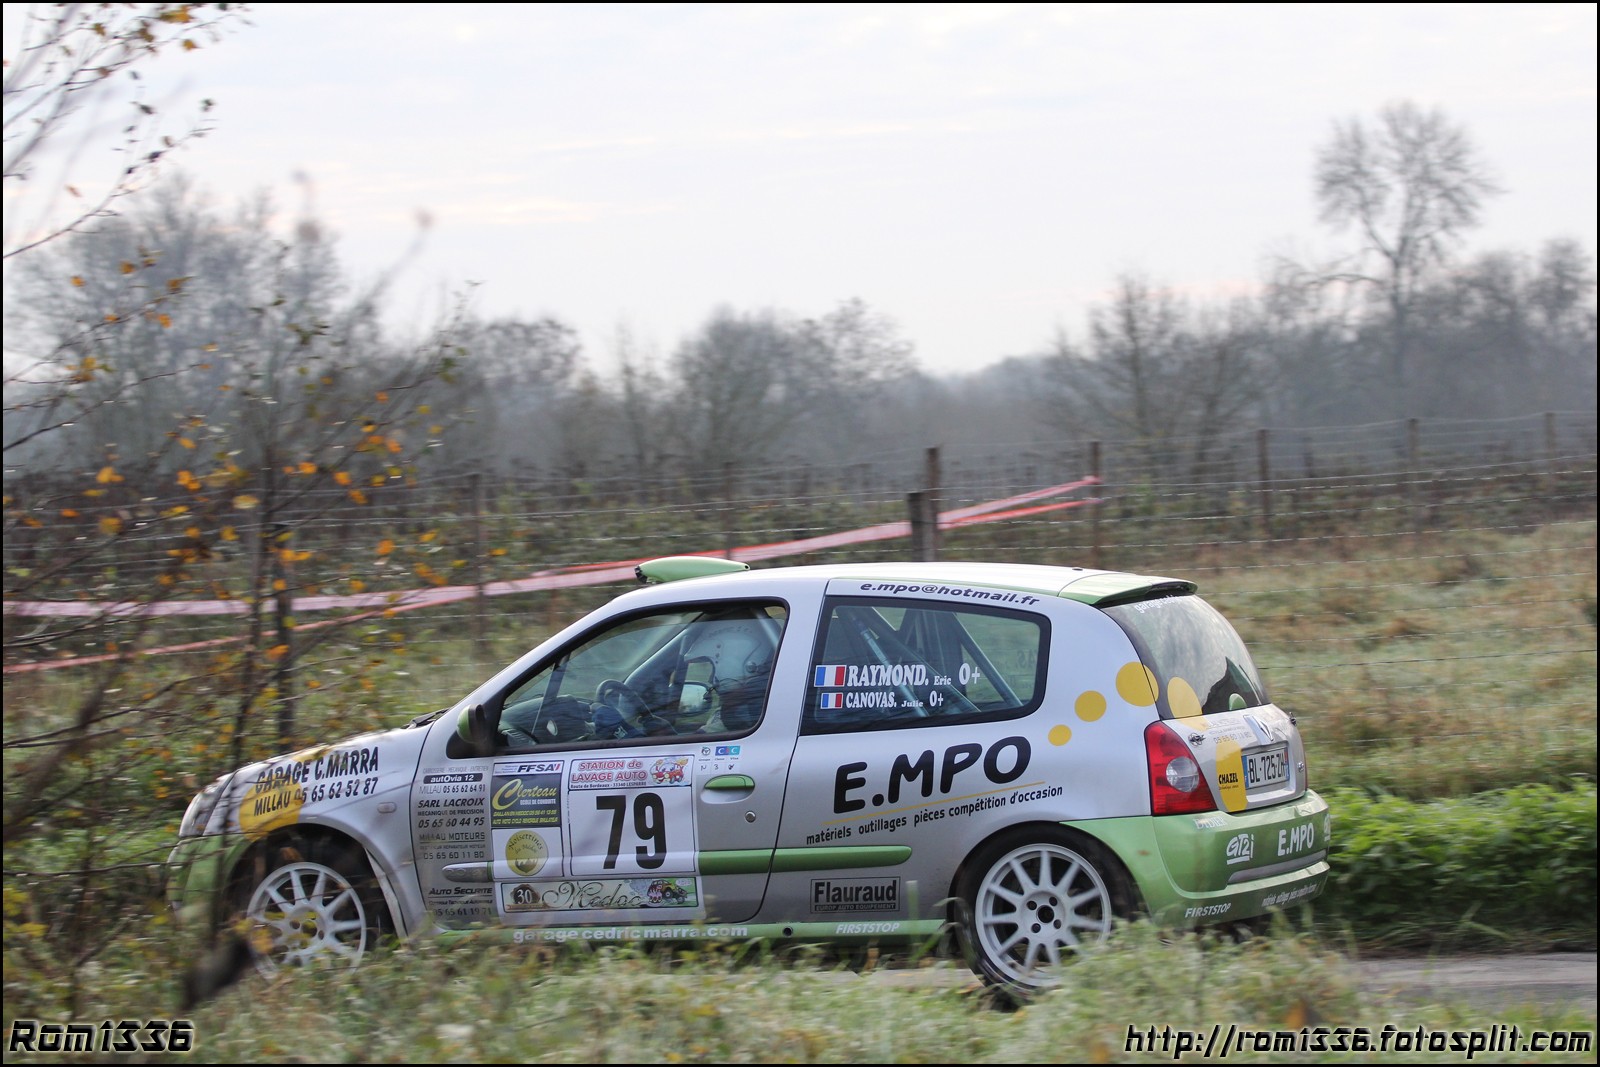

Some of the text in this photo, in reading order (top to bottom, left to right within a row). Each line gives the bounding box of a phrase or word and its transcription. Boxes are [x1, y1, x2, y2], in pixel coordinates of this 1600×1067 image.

[860, 582, 1040, 606] e.mpo@hotmail.fr
[933, 675, 951, 686] Eric
[901, 699, 924, 708] Julie
[256, 746, 379, 793] GARAGE C.MARRA
[579, 759, 643, 771] STATION de
[430, 775, 462, 783] autOvia
[571, 770, 648, 782] LAVAGE AUTO
[833, 736, 1032, 813] E.MPO
[1218, 772, 1239, 785] CHAZEL
[452, 785, 459, 793] 65
[460, 785, 468, 793] 62
[469, 784, 477, 792] 64
[491, 779, 557, 810] Clerteau
[254, 791, 291, 817] MILLAU
[311, 784, 325, 802] 65
[328, 782, 341, 800] 62
[345, 780, 359, 797] 52
[363, 777, 379, 795] 87
[418, 798, 485, 808] SARL LACROIX
[806, 785, 1063, 845] matériels outillages pièces compétition d'occasion
[418, 817, 485, 828] 05 65 60 44 95
[449, 832, 485, 840] MOTEURS
[596, 792, 667, 870] 79
[1277, 822, 1315, 857] E.MPO
[462, 851, 471, 859] 11
[474, 851, 485, 859] 80
[428, 887, 452, 895] AUTO
[517, 889, 532, 904] 30
[814, 880, 897, 904] Flauraud
[457, 908, 467, 916] 61
[1184, 903, 1232, 918] FIRSTSTOP
[835, 921, 901, 934] FIRSTSTOP
